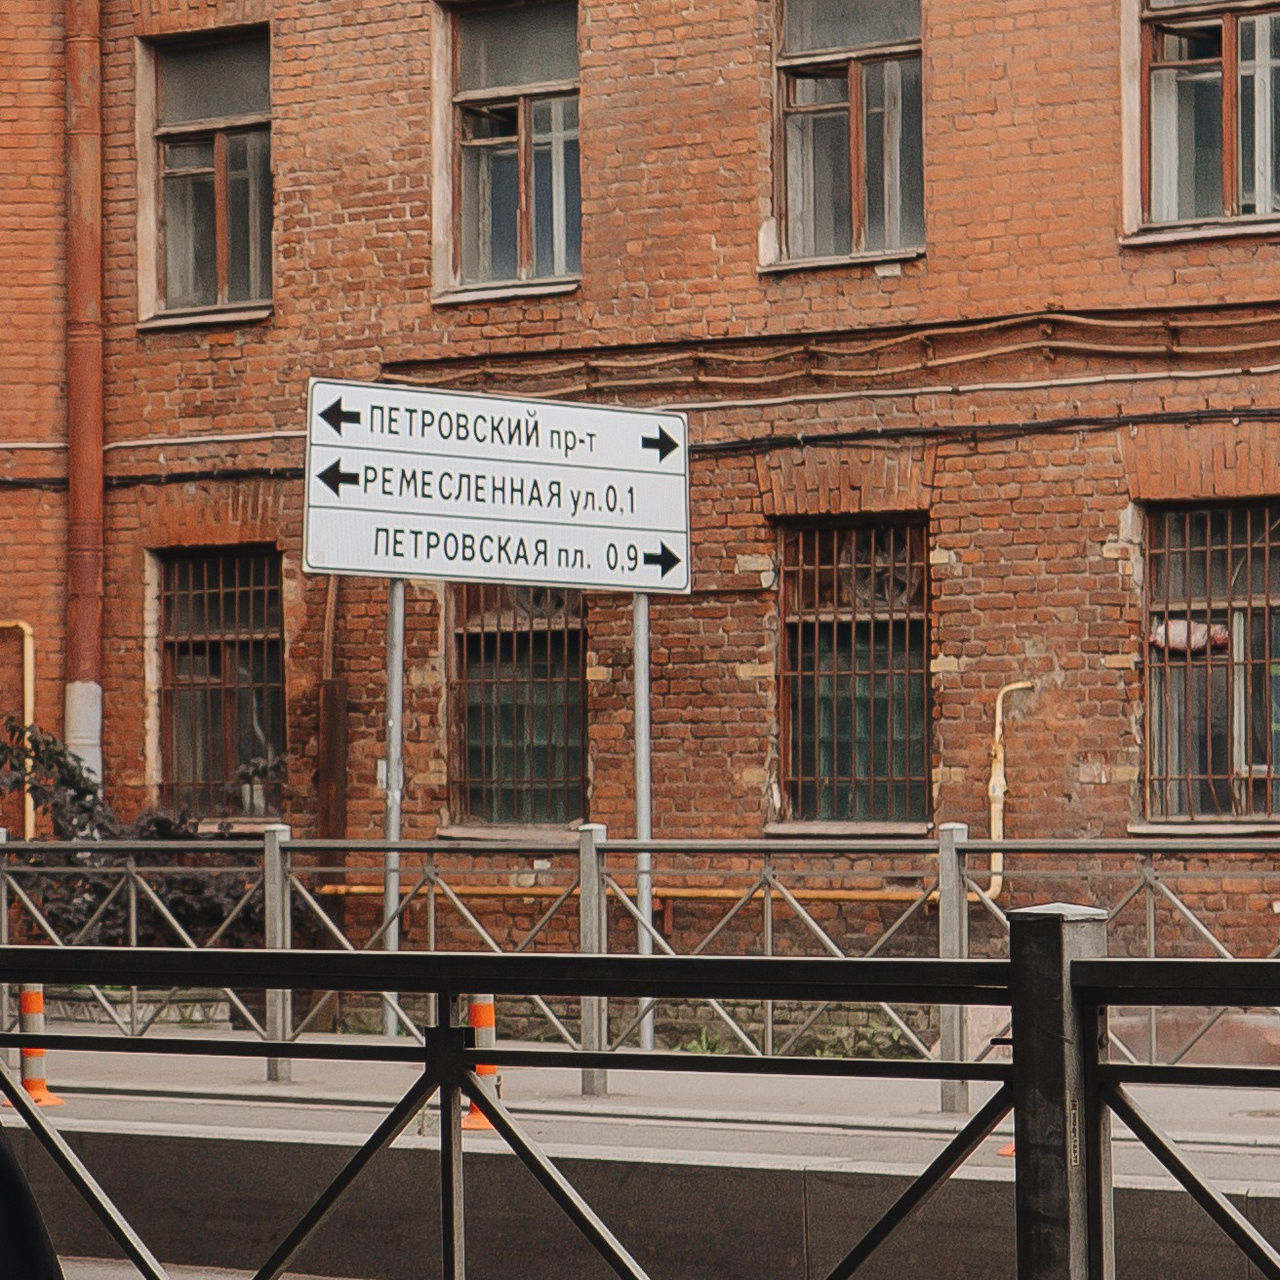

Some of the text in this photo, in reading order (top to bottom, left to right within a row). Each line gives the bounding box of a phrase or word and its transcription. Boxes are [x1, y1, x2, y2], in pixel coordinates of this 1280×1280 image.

[369, 404, 597, 458] ПЕТРОВСКИЙ пр-т
[363, 465, 562, 508] РЕМЕСЛЕННАЯ
[373, 527, 548, 567] ПЕТРОВСКАЯ
[557, 547, 592, 570] пл.
